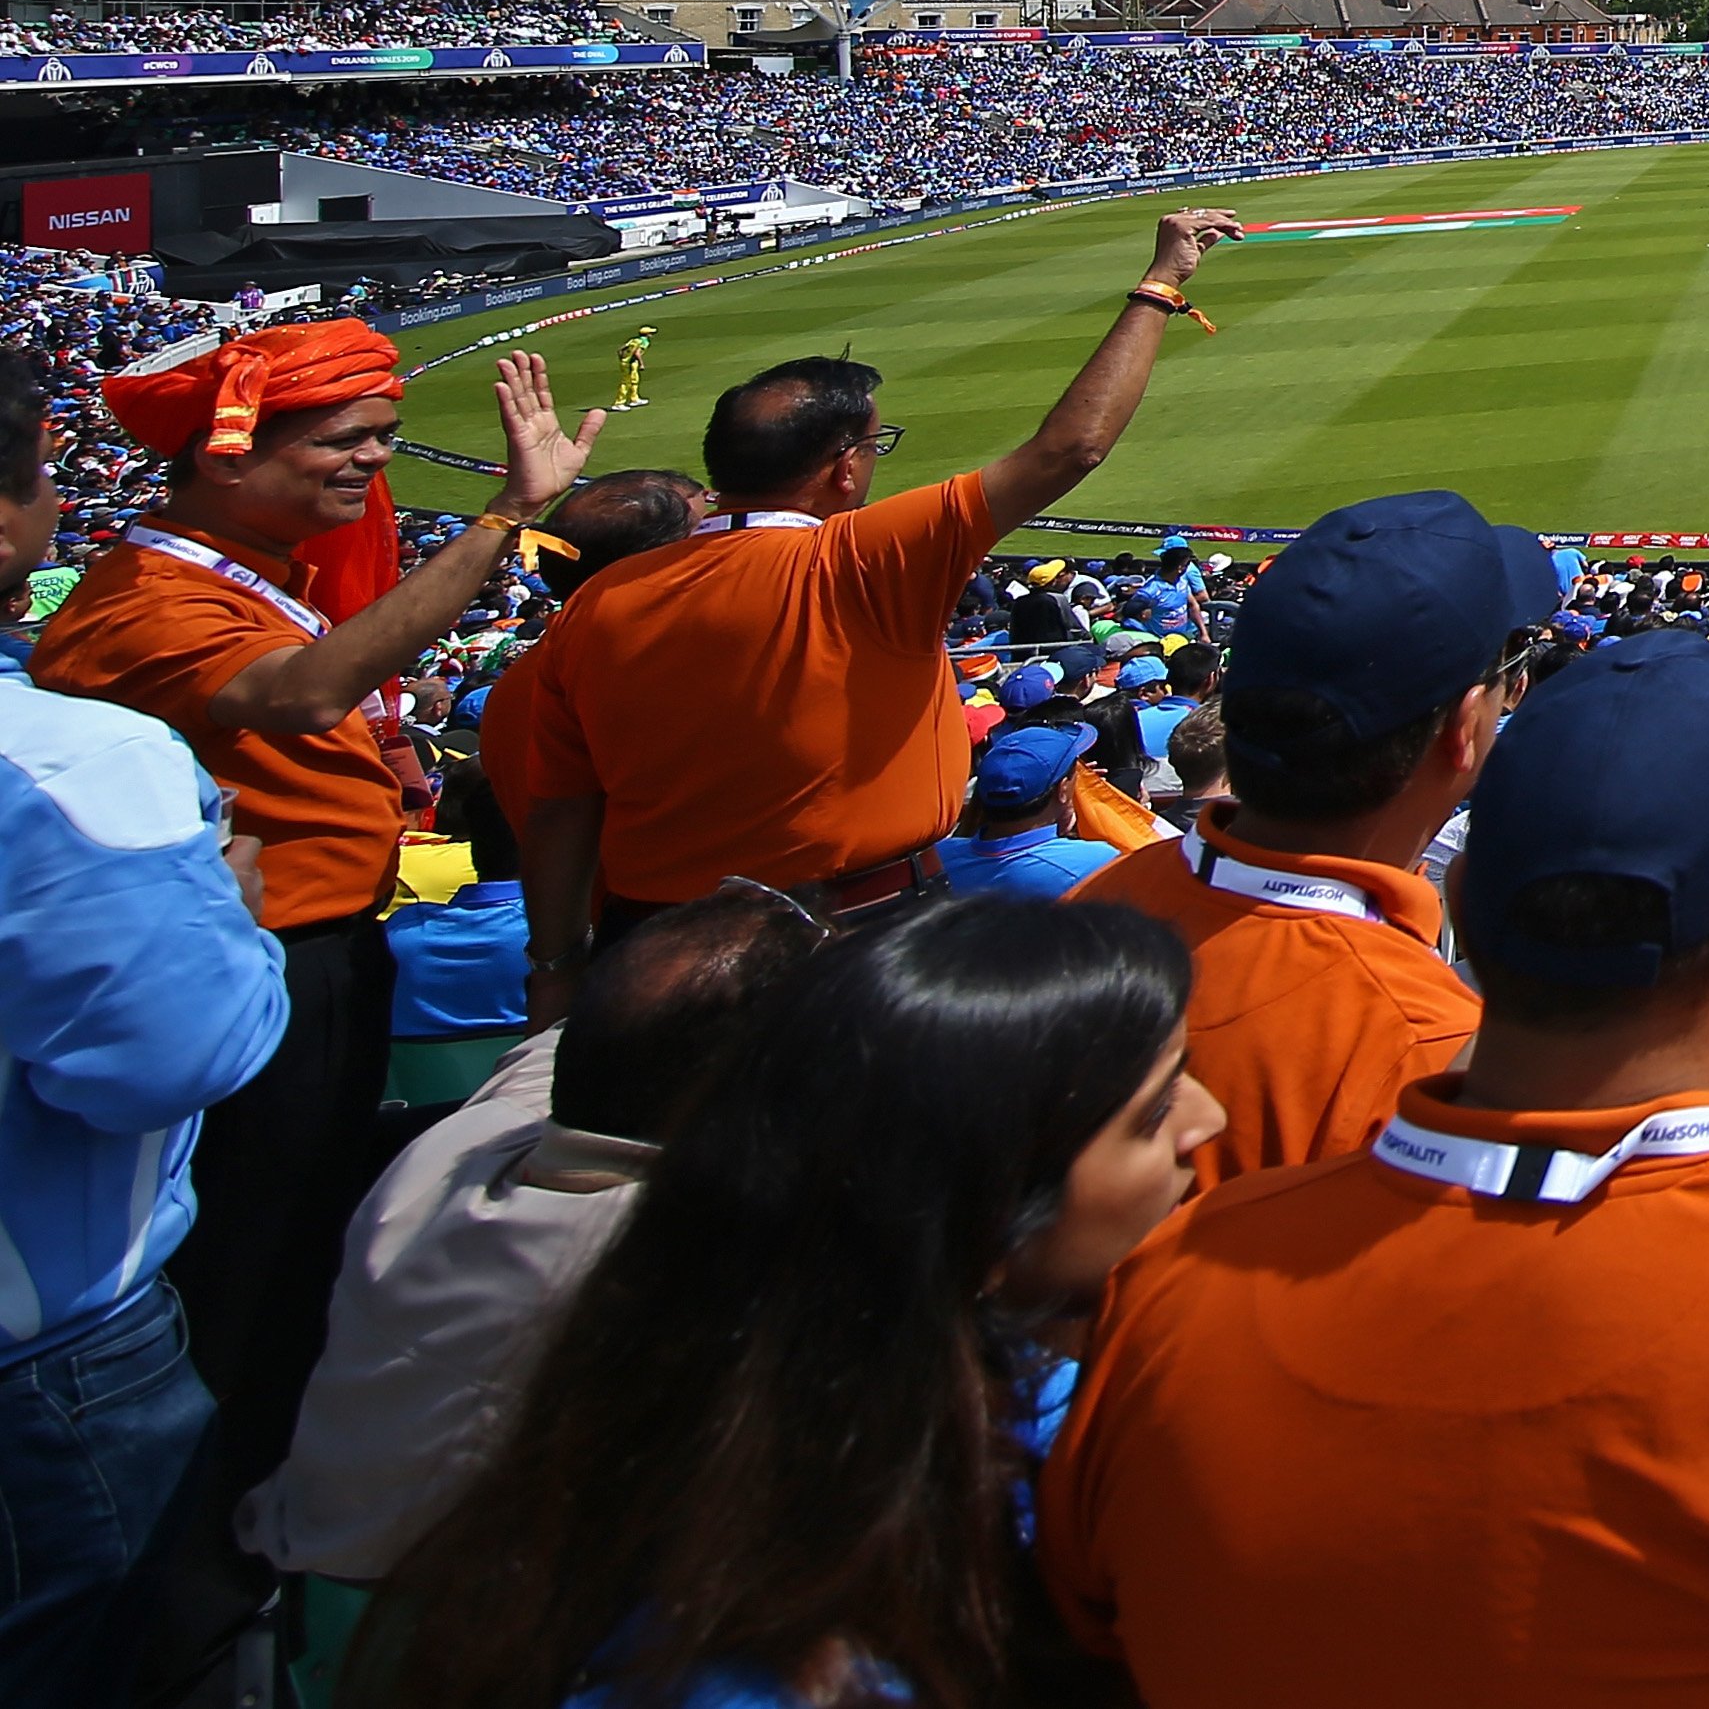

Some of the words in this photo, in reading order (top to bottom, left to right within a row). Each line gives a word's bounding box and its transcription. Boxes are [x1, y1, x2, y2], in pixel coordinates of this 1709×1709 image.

[331, 57, 369, 65] ENGLAND
[376, 56, 401, 64] WALES
[1260, 162, 1305, 173] Booking.com
[1328, 158, 1370, 167] ooking.com
[1194, 169, 1240, 180] Booking.com
[1126, 176, 1174, 188] Booking.com
[1061, 183, 1108, 195] Booking.com
[706, 192, 748, 202] CELEBRATION
[619, 203, 647, 212] WORLD'S
[648, 200, 673, 209] GREATE
[49, 207, 130, 230] NISSAN
[831, 224, 866, 238] Booking.com
[781, 233, 818, 248] Booking.com
[704, 241, 746, 258] Booking.com
[640, 254, 686, 271] Booking.com
[486, 286, 543, 307] Booking.com
[1538, 534, 1585, 543] Booking.com
[29, 576, 64, 587] GREEN
[34, 589, 62, 598] TEAM
[1262, 880, 1344, 902] HOSPITALITY
